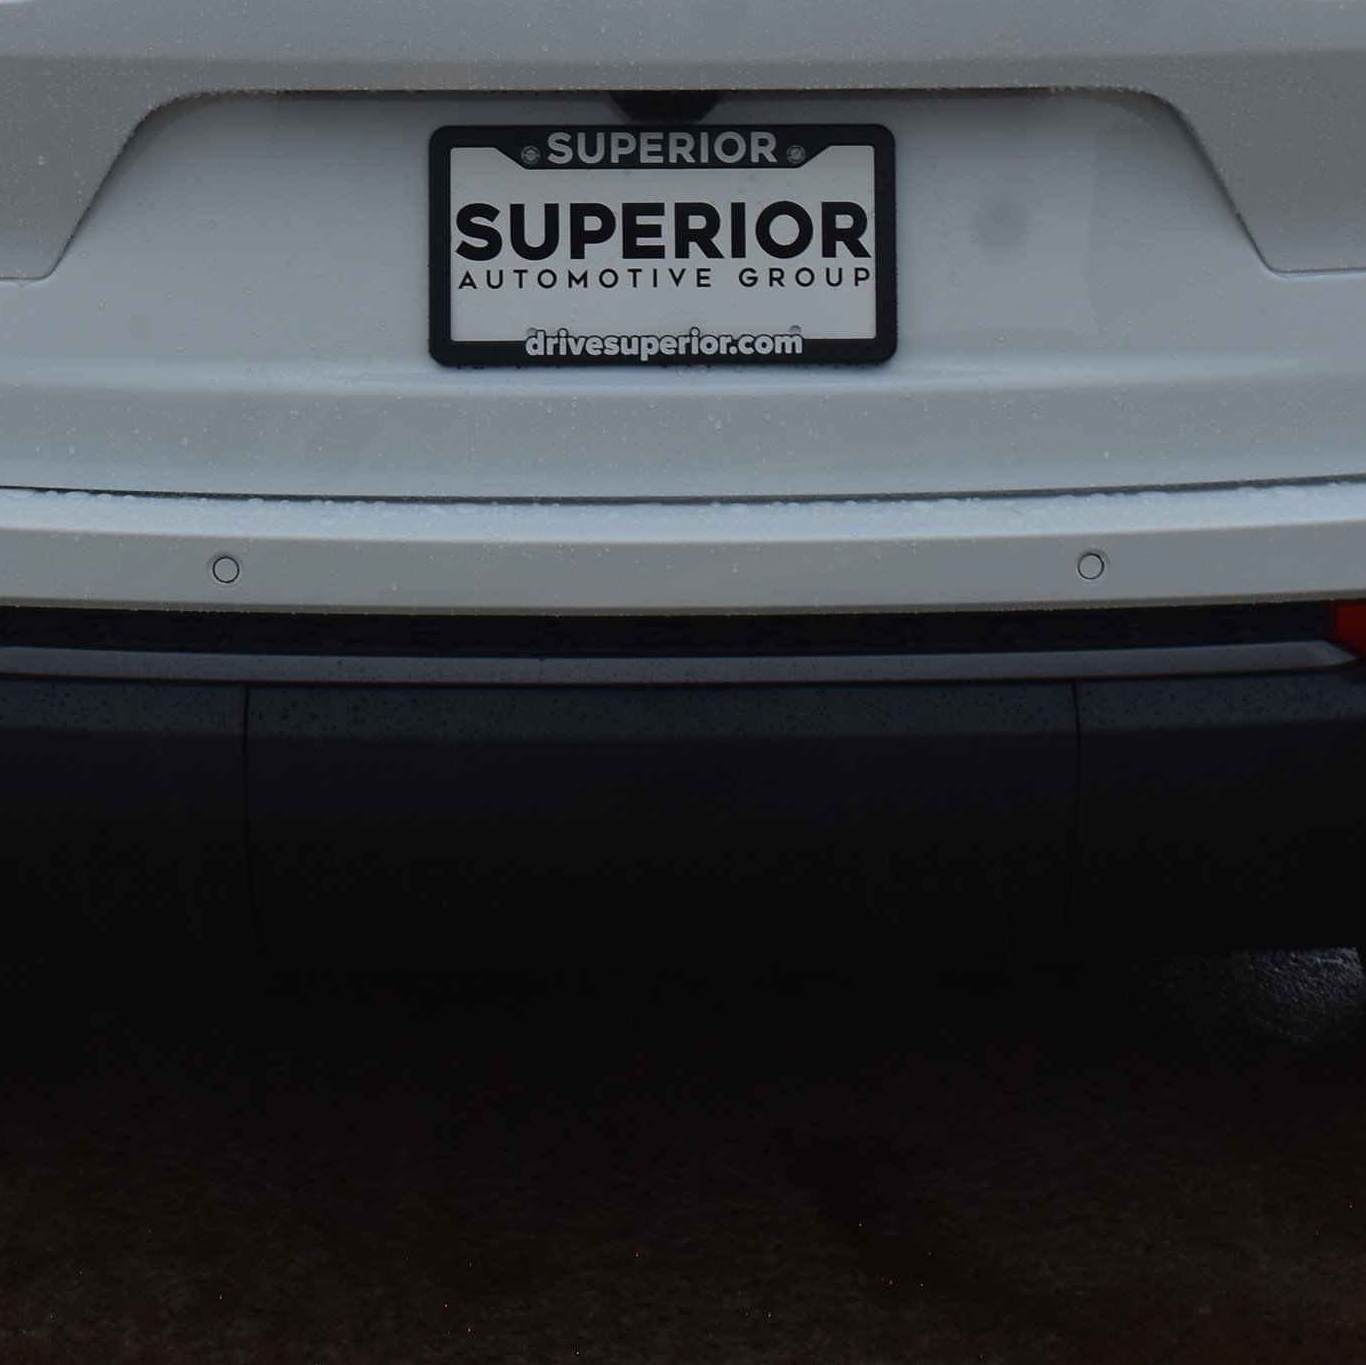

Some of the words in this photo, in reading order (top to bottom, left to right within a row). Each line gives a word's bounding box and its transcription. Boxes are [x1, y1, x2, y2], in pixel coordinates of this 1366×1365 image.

[546, 131, 778, 165] SUPERIOR
[455, 200, 872, 261] SUPERIOR
[458, 267, 712, 290] AUTOMOTIVE
[738, 266, 872, 288] GROUP
[525, 327, 804, 362] drivesuperior.com
